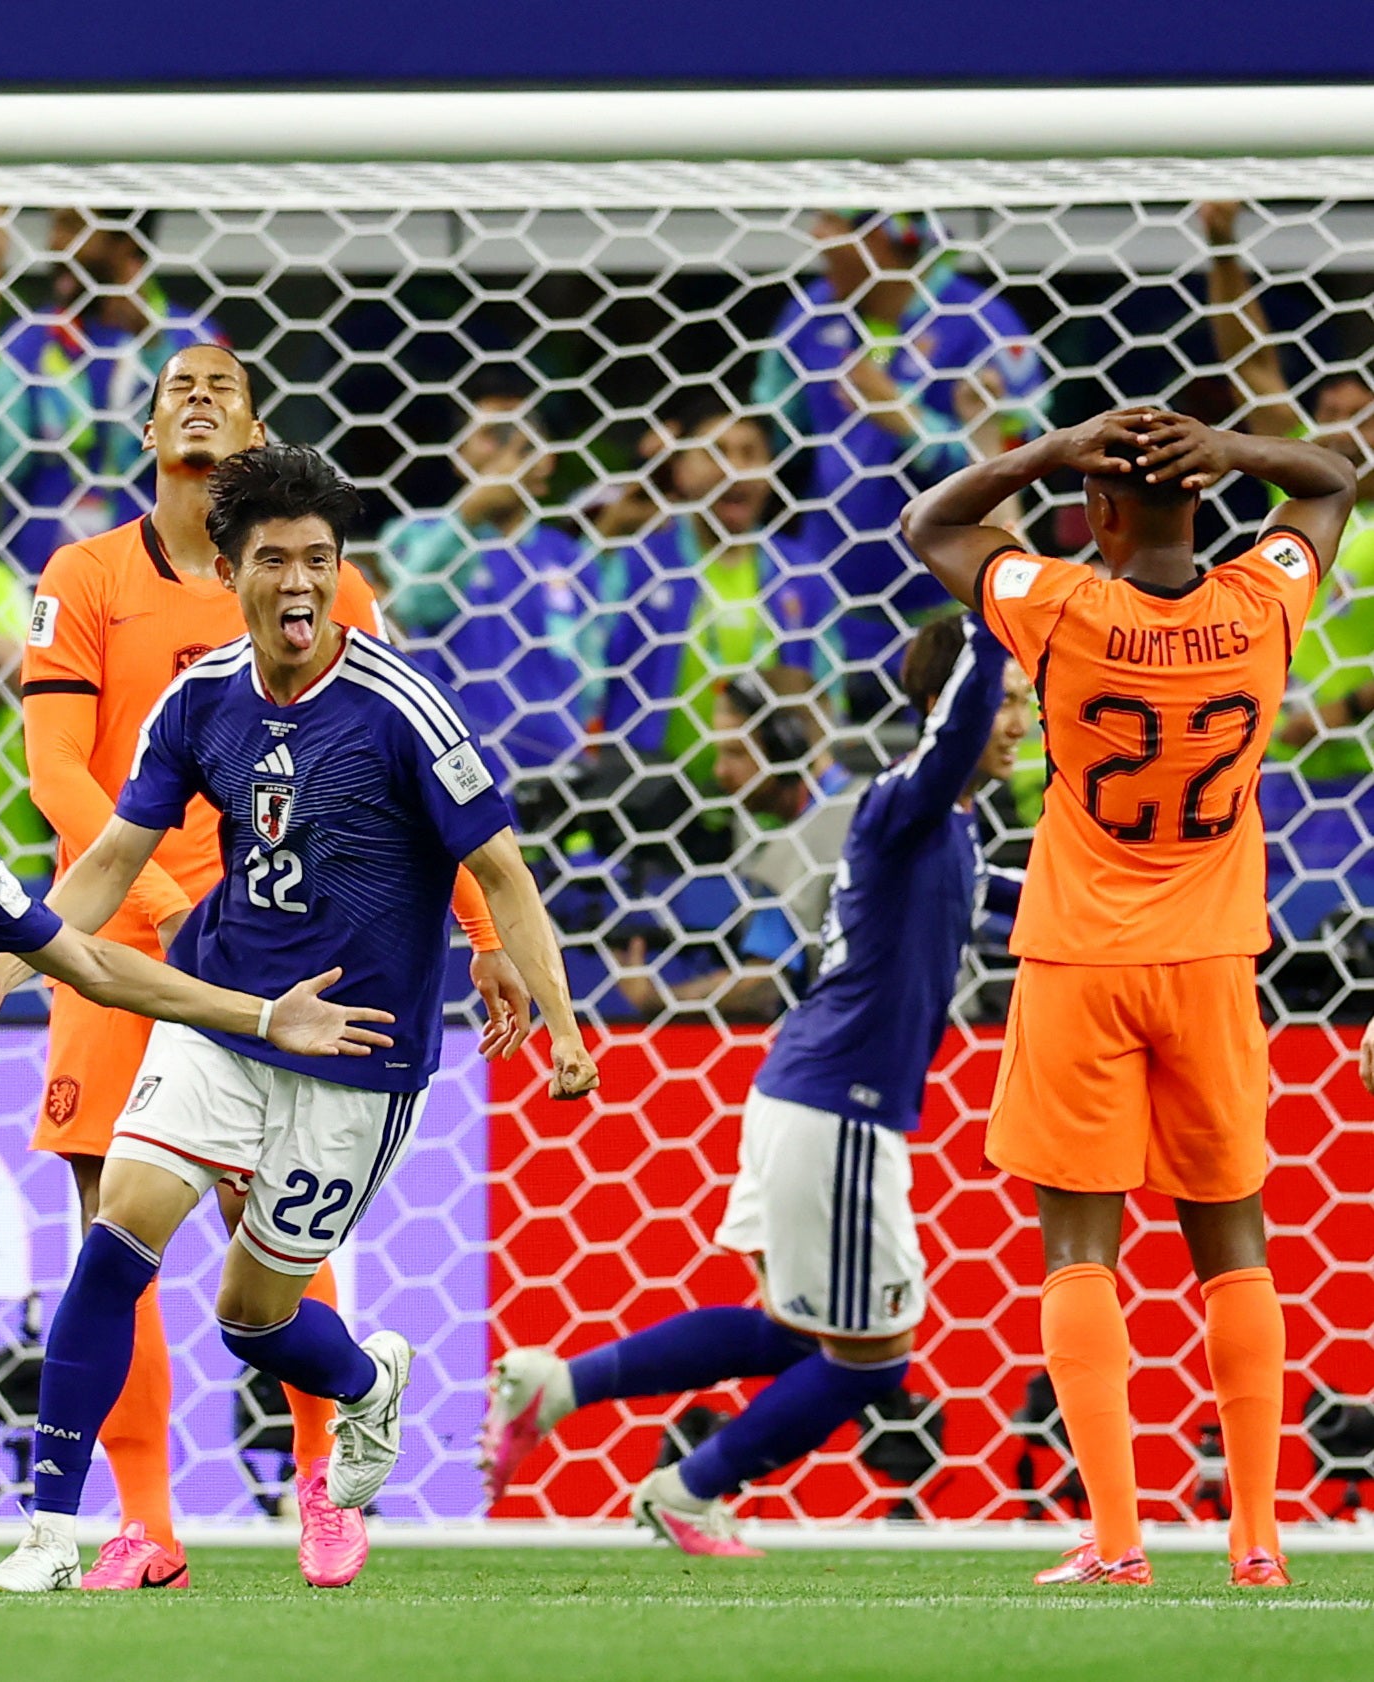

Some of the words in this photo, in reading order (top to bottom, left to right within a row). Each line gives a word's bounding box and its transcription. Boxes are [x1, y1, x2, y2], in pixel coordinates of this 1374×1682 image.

[1105, 621, 1249, 666] DUMFRIES
[1079, 690, 1260, 844] 22
[244, 845, 308, 913] 22
[272, 1168, 353, 1240] 22
[34, 1422, 81, 1441] APAN
